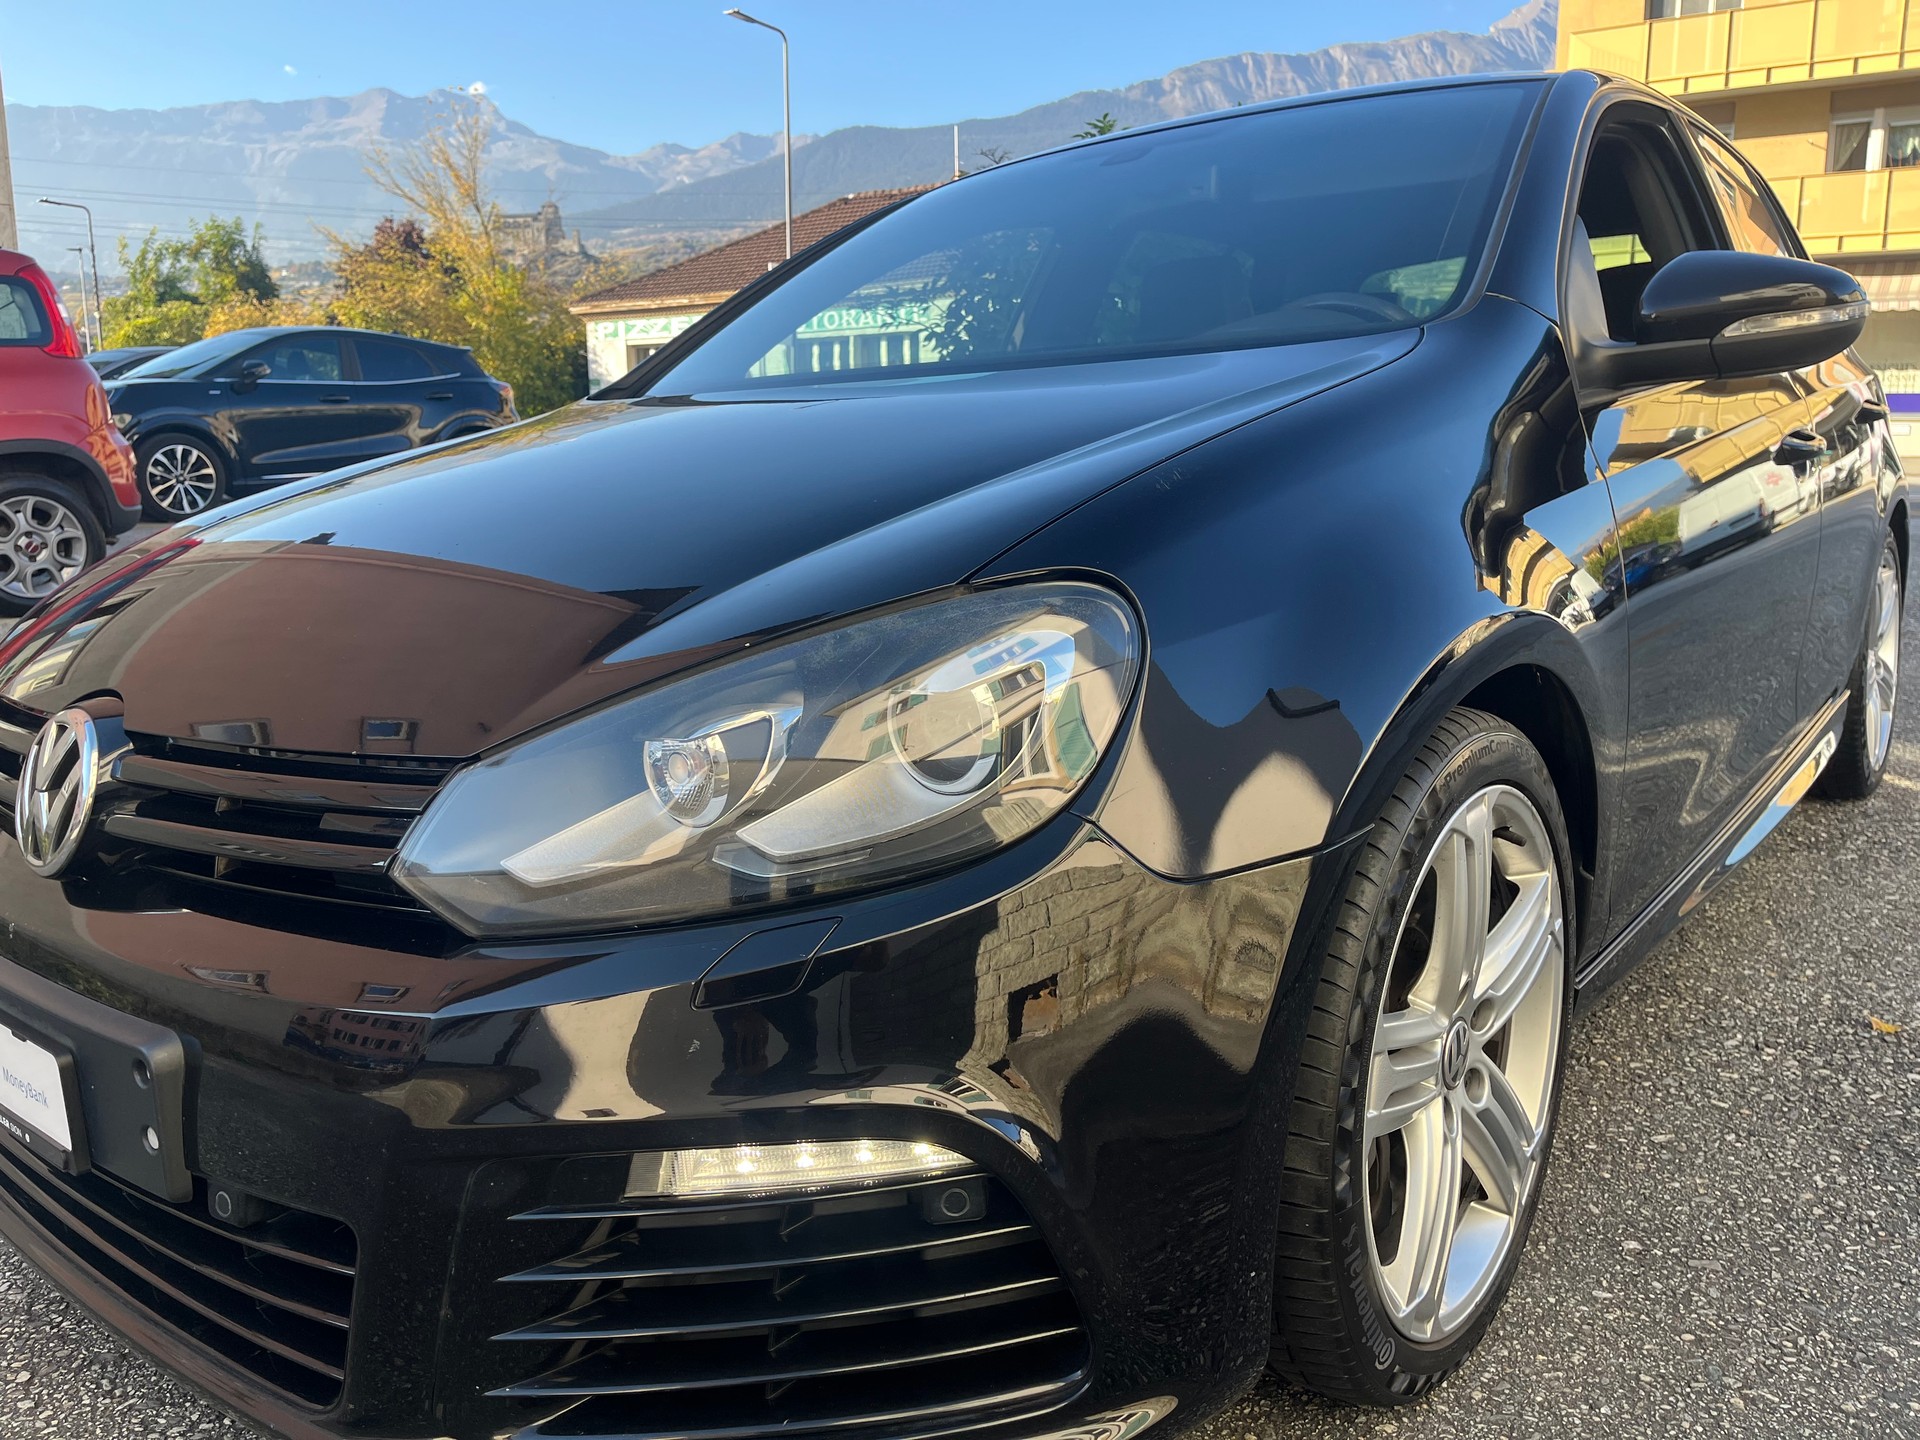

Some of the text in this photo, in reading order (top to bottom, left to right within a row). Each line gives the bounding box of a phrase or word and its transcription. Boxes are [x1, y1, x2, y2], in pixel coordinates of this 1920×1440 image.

[596, 316, 697, 341] PIZZE
[2, 1065, 49, 1109] MoneyBank
[1344, 1248, 1396, 1370] Continental
